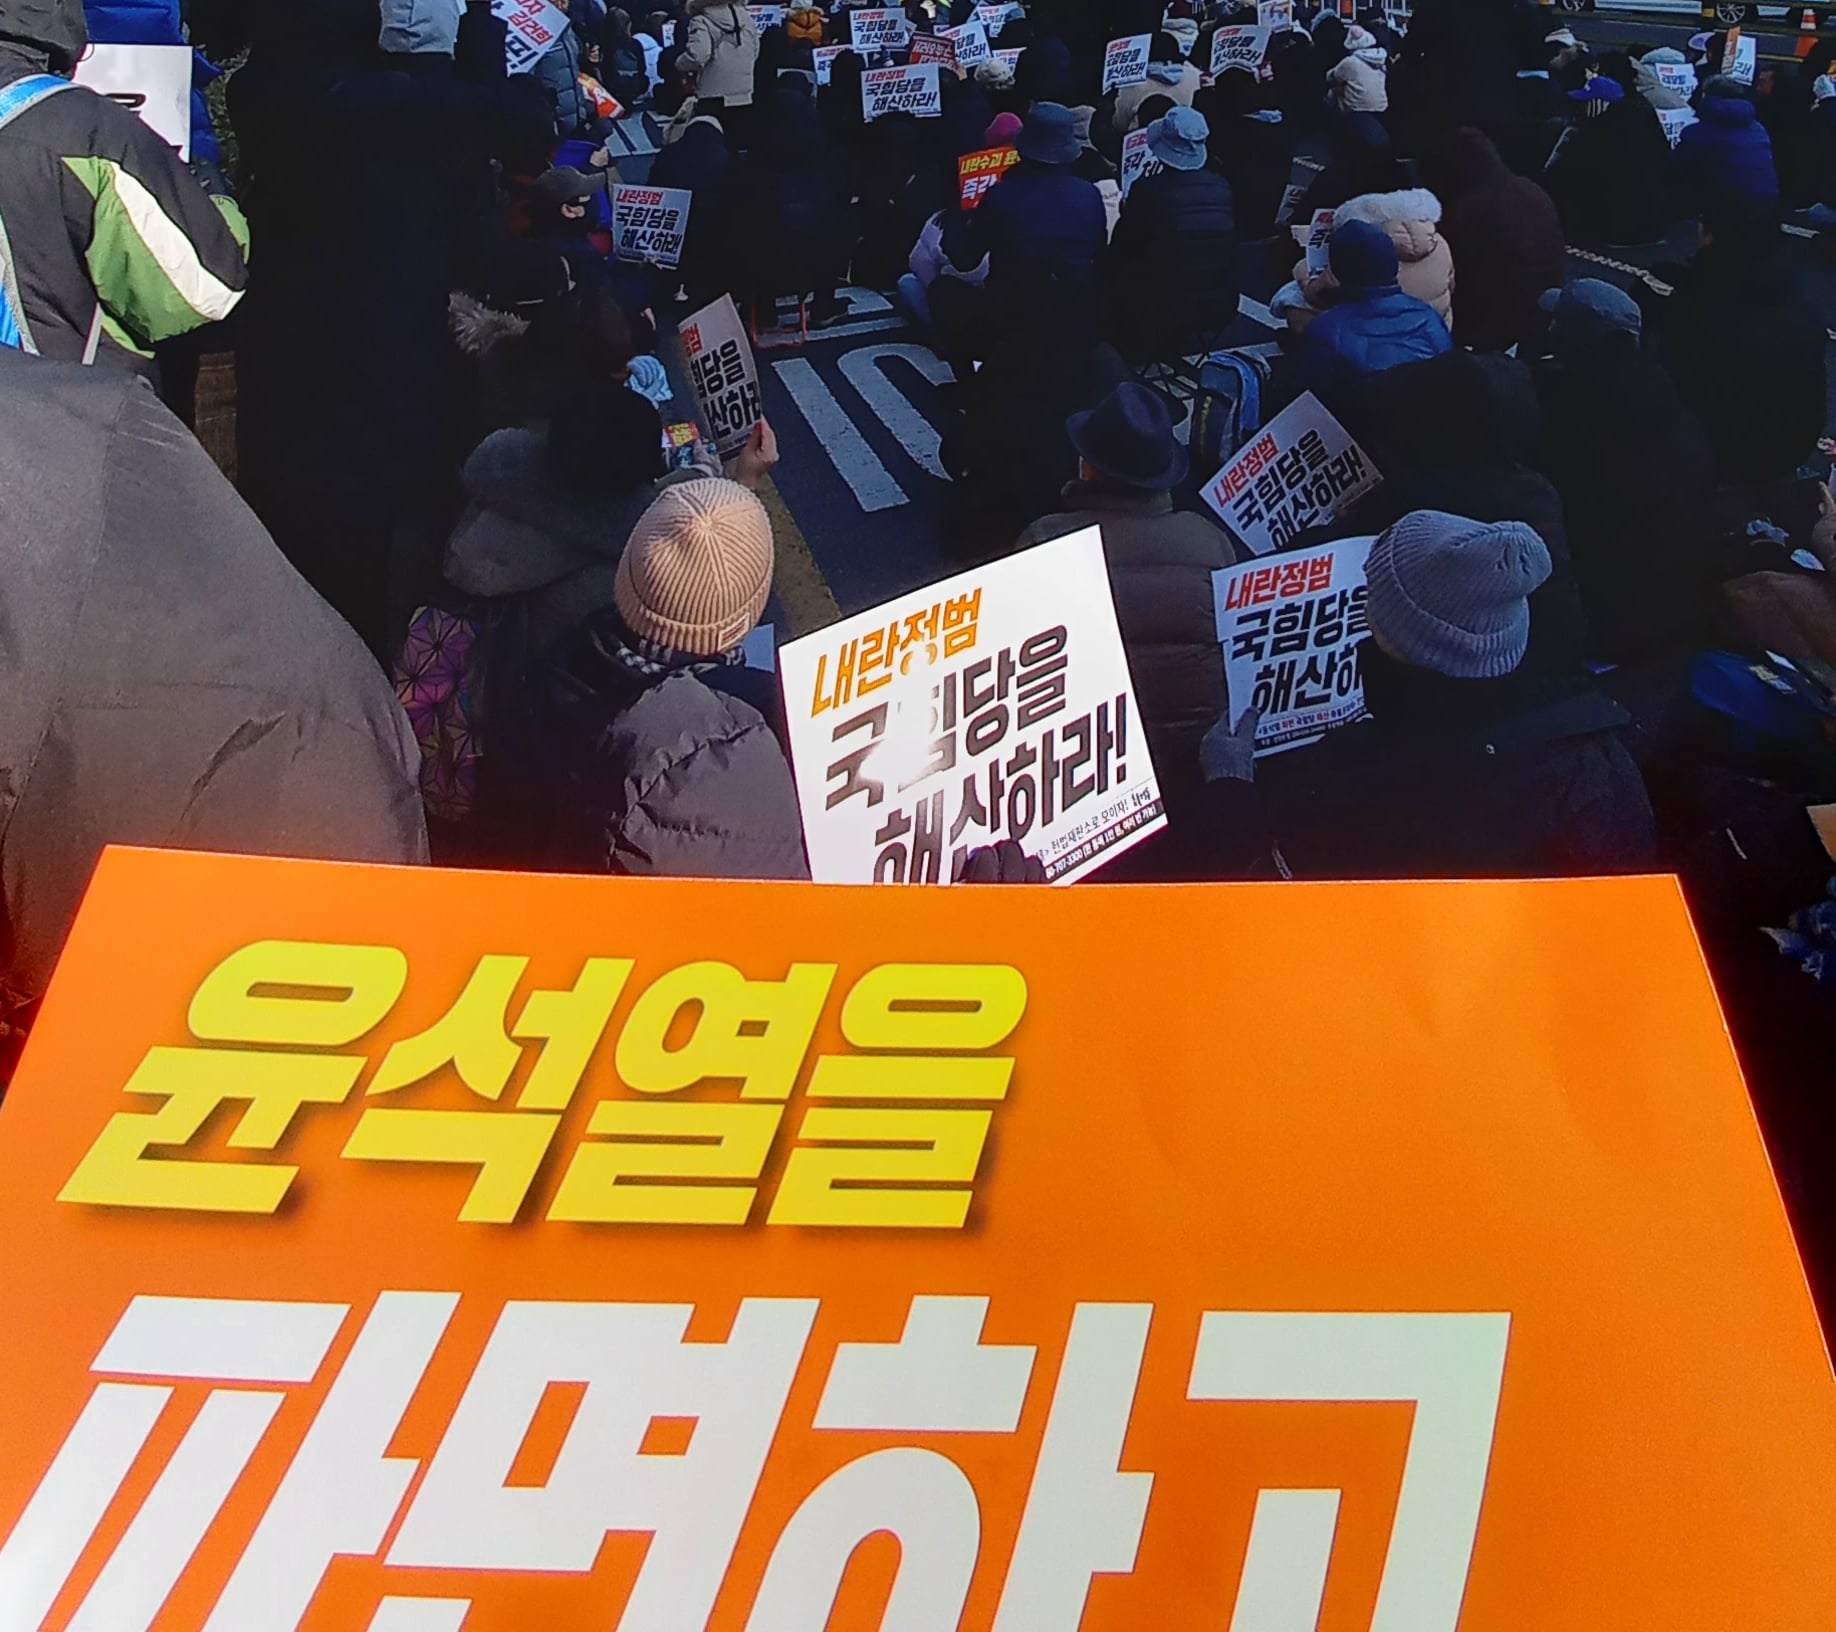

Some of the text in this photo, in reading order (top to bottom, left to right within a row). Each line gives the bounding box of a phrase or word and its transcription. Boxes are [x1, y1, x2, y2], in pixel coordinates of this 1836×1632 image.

[506, 9, 554, 46] 김건희
[853, 19, 899, 33] 국힘당을
[859, 31, 905, 46] 해산하라!
[864, 69, 907, 83] 내란정범
[865, 77, 926, 97] 국힘당을
[872, 91, 937, 112] 해산하라!
[615, 188, 664, 206] 내란정범
[615, 205, 680, 230] 국힘당을
[620, 227, 682, 254] 해산하라!
[1213, 431, 1279, 506] 내란정범
[1231, 428, 1330, 530] 국힘당을
[1267, 444, 1368, 550] 해산하라!
[1224, 552, 1334, 612] 내란정범
[811, 586, 984, 719] 내란정범
[1251, 644, 1364, 715] 해산하
[873, 691, 1128, 886] 해산하라!
[54, 937, 1030, 1231] 윤석열을
